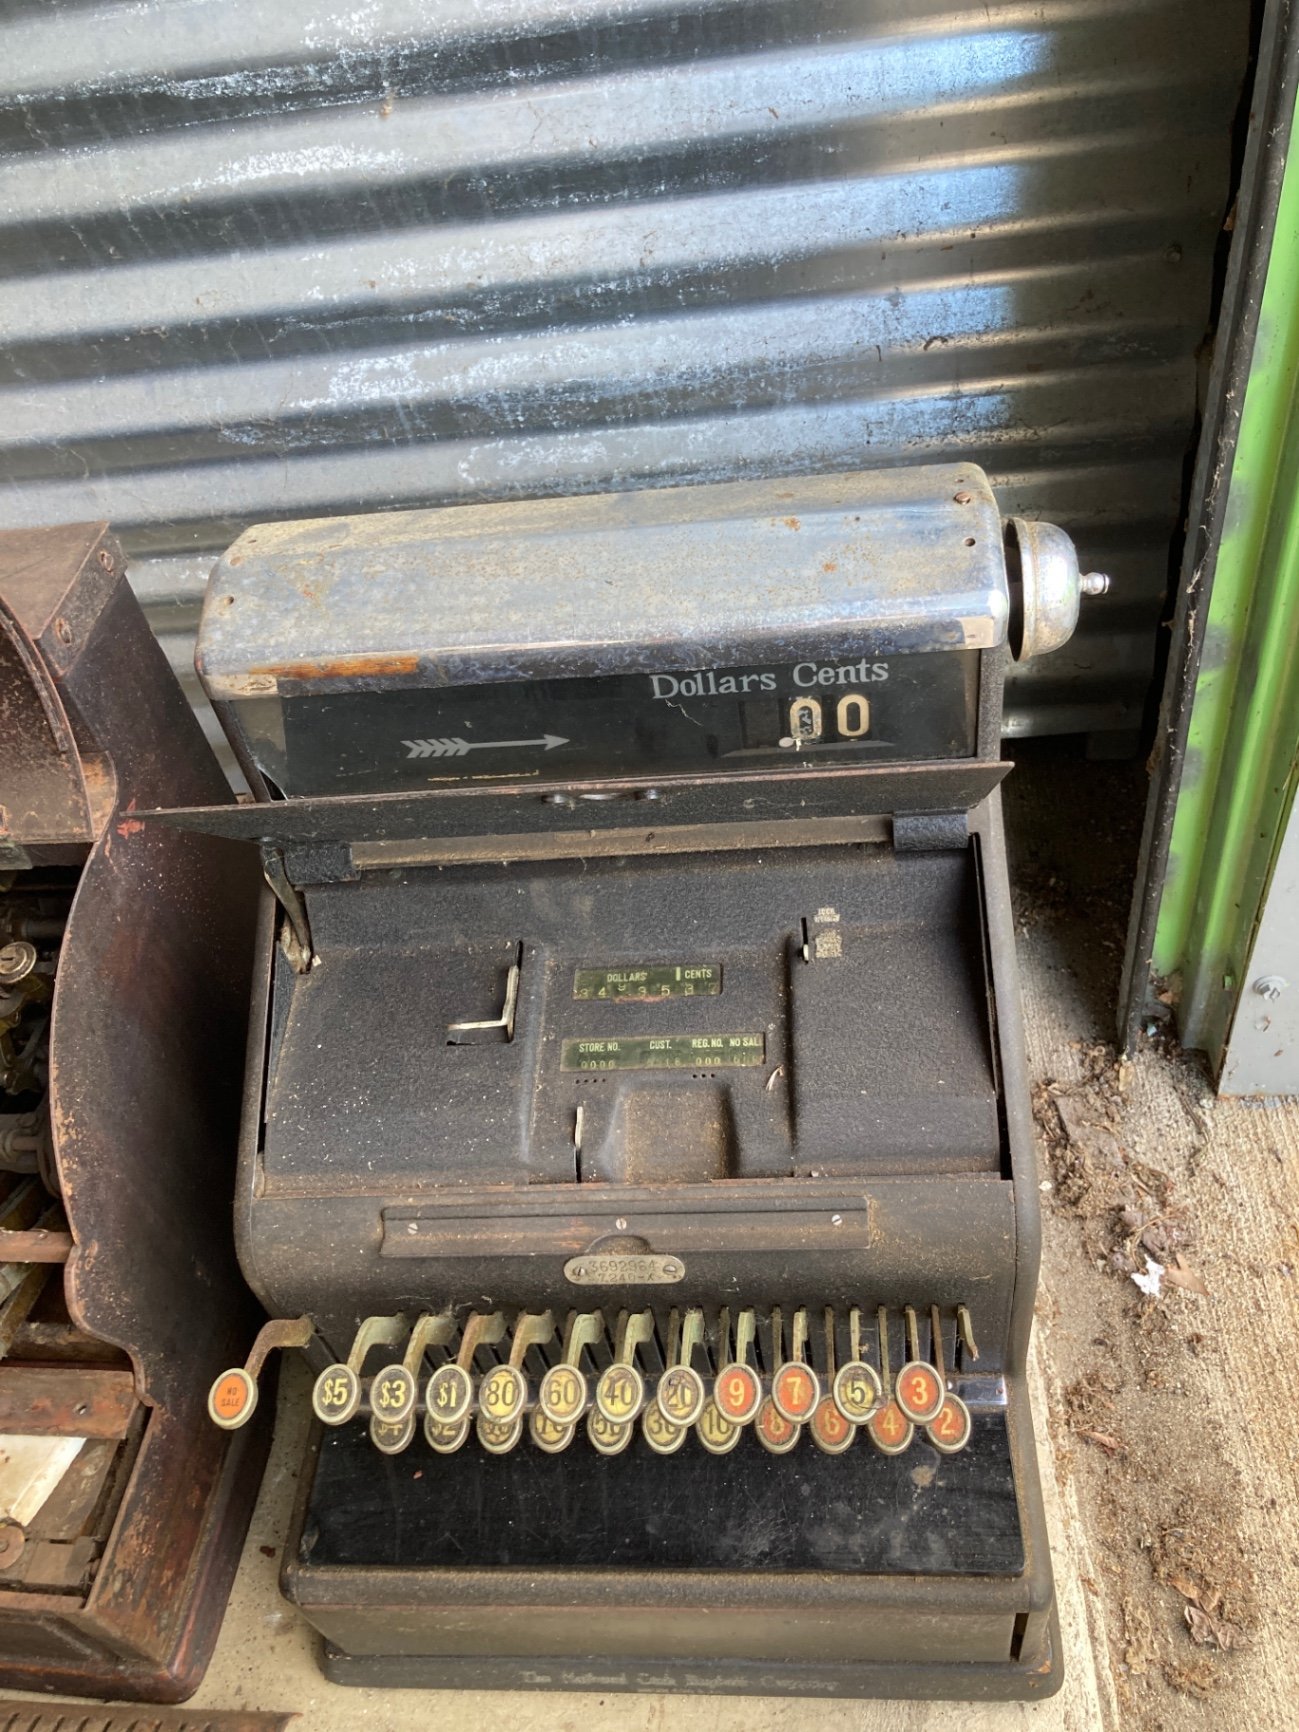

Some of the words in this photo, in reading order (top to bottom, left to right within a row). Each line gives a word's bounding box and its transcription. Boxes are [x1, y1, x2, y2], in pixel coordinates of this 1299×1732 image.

[650, 671, 777, 699] Dollars
[793, 658, 889, 687] Cents
[607, 972, 648, 983] DOLLARS
[684, 969, 712, 979] CENTS
[579, 1042, 605, 1053] STORE
[649, 1039, 673, 1050] CUST.
[729, 1037, 741, 1047] NO
[221, 1397, 240, 1407] SALE
[227, 1387, 238, 1395] NO
[322, 1378, 348, 1406] $5
[379, 1379, 407, 1408] $3
[437, 1381, 457, 1408] $1
[487, 1379, 515, 1406] 80
[550, 1380, 576, 1406] 60
[604, 1377, 633, 1407] 40
[729, 1378, 745, 1406] 9
[787, 1376, 802, 1405] 7
[850, 1380, 866, 1405] 5
[911, 1376, 928, 1405] 3
[707, 1410, 730, 1435] 10
[824, 1408, 840, 1435] 6
[882, 1408, 899, 1436] 4
[938, 1407, 955, 1435] 2
